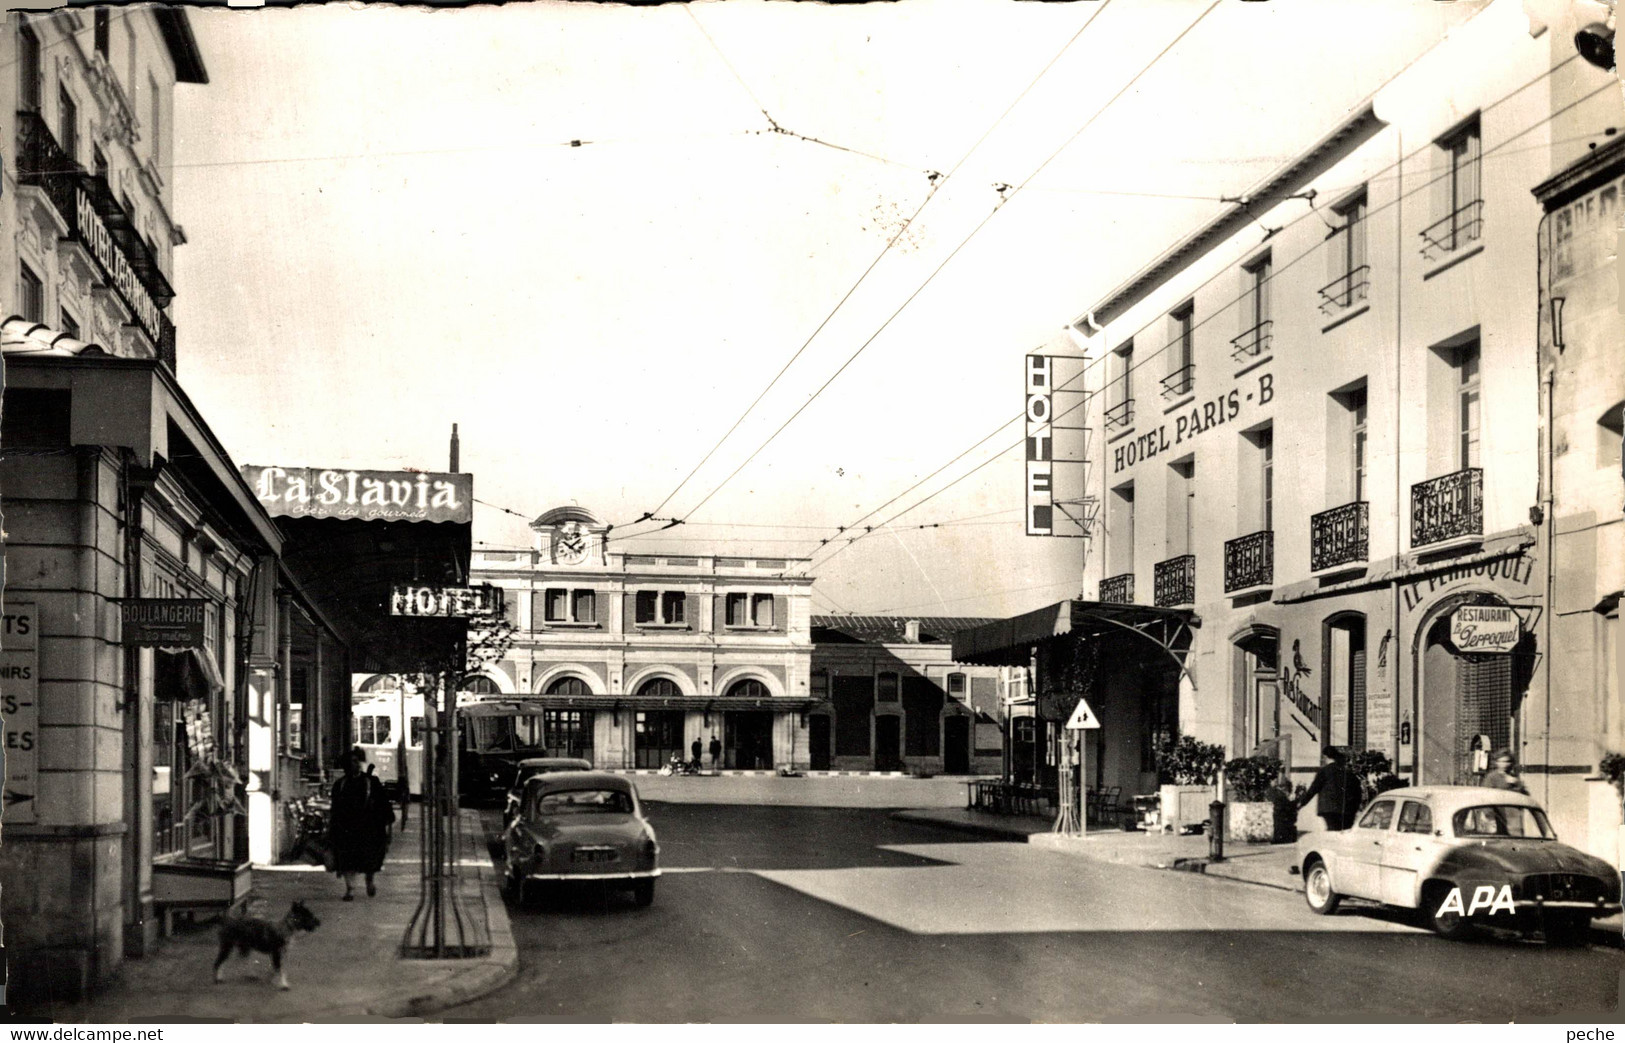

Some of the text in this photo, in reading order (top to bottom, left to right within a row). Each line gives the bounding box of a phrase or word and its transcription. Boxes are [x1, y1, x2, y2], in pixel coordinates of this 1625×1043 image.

[77, 187, 113, 279] HOTEL
[1028, 357, 1051, 534] HOTEL
[1114, 424, 1170, 473] HOTEL
[1176, 389, 1240, 444] PARIS
[257, 467, 462, 509] La Slavia
[338, 507, 359, 516] des
[391, 586, 493, 616] HOTEL
[1403, 582, 1424, 612] LE
[122, 605, 204, 622] BOULANGERIE
[1457, 608, 1511, 622] RESTAURANT
[1459, 624, 1518, 651] Perroquet
[1281, 666, 1321, 730] Restaurant
